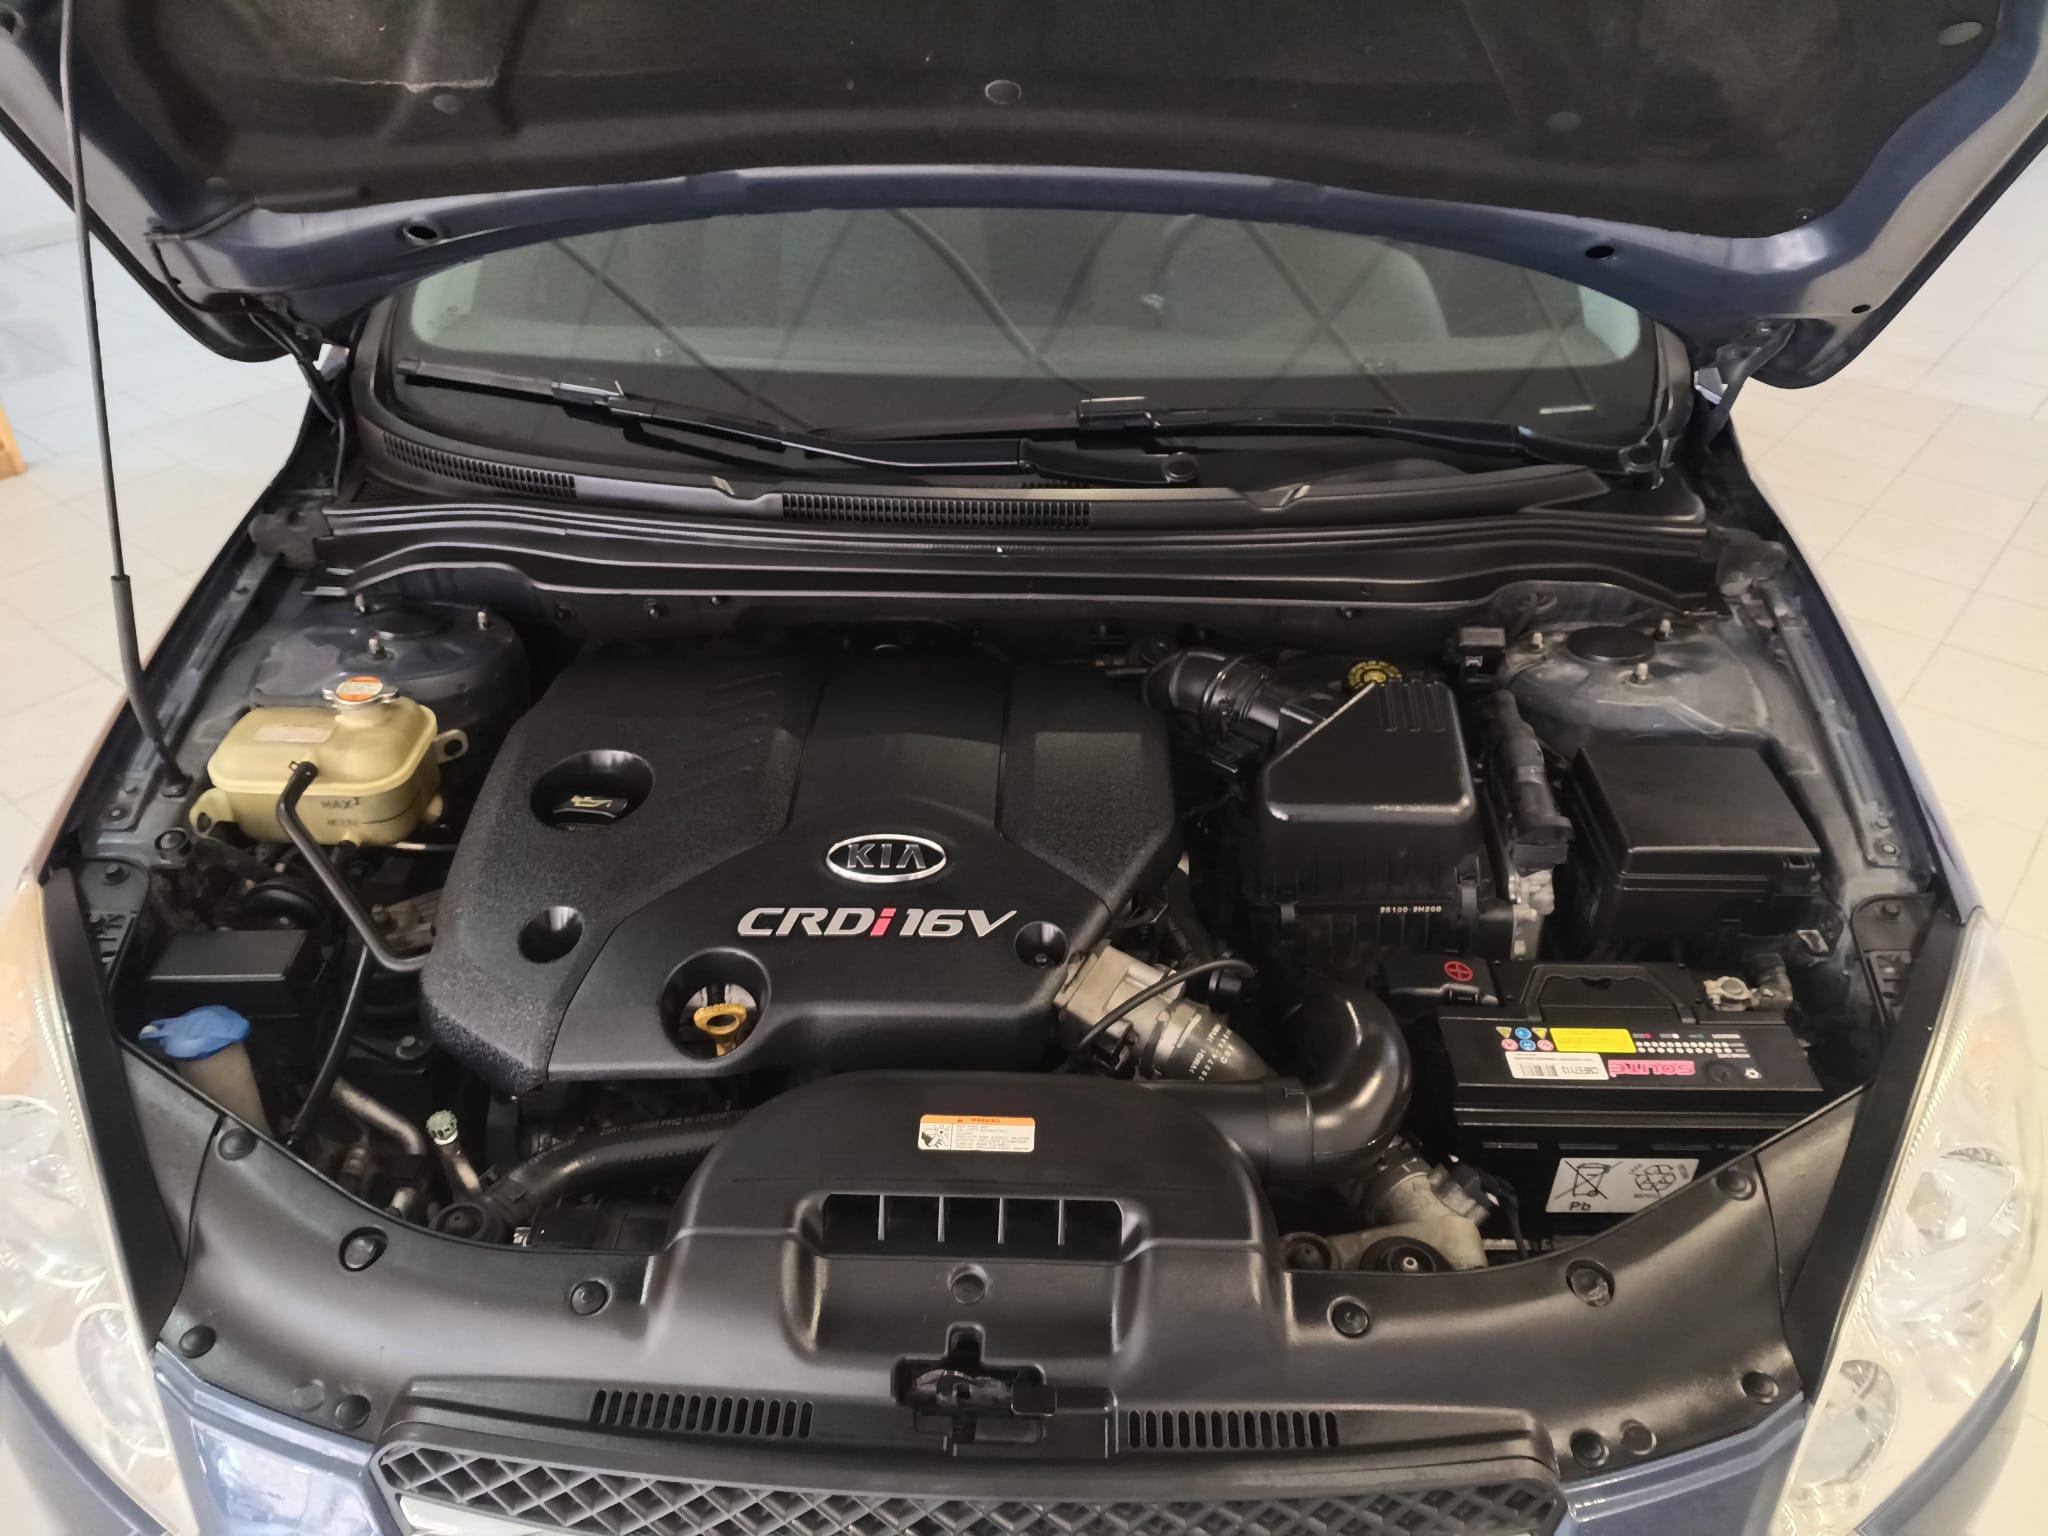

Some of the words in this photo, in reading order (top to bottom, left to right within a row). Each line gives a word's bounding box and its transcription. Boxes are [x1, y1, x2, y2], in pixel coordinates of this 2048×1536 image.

[847, 843, 927, 869] KIA
[737, 907, 897, 938] CRDi
[899, 907, 1018, 938] 16V
[1608, 1061, 1695, 1076] SOLITE
[1568, 1201, 1592, 1211] Pb
